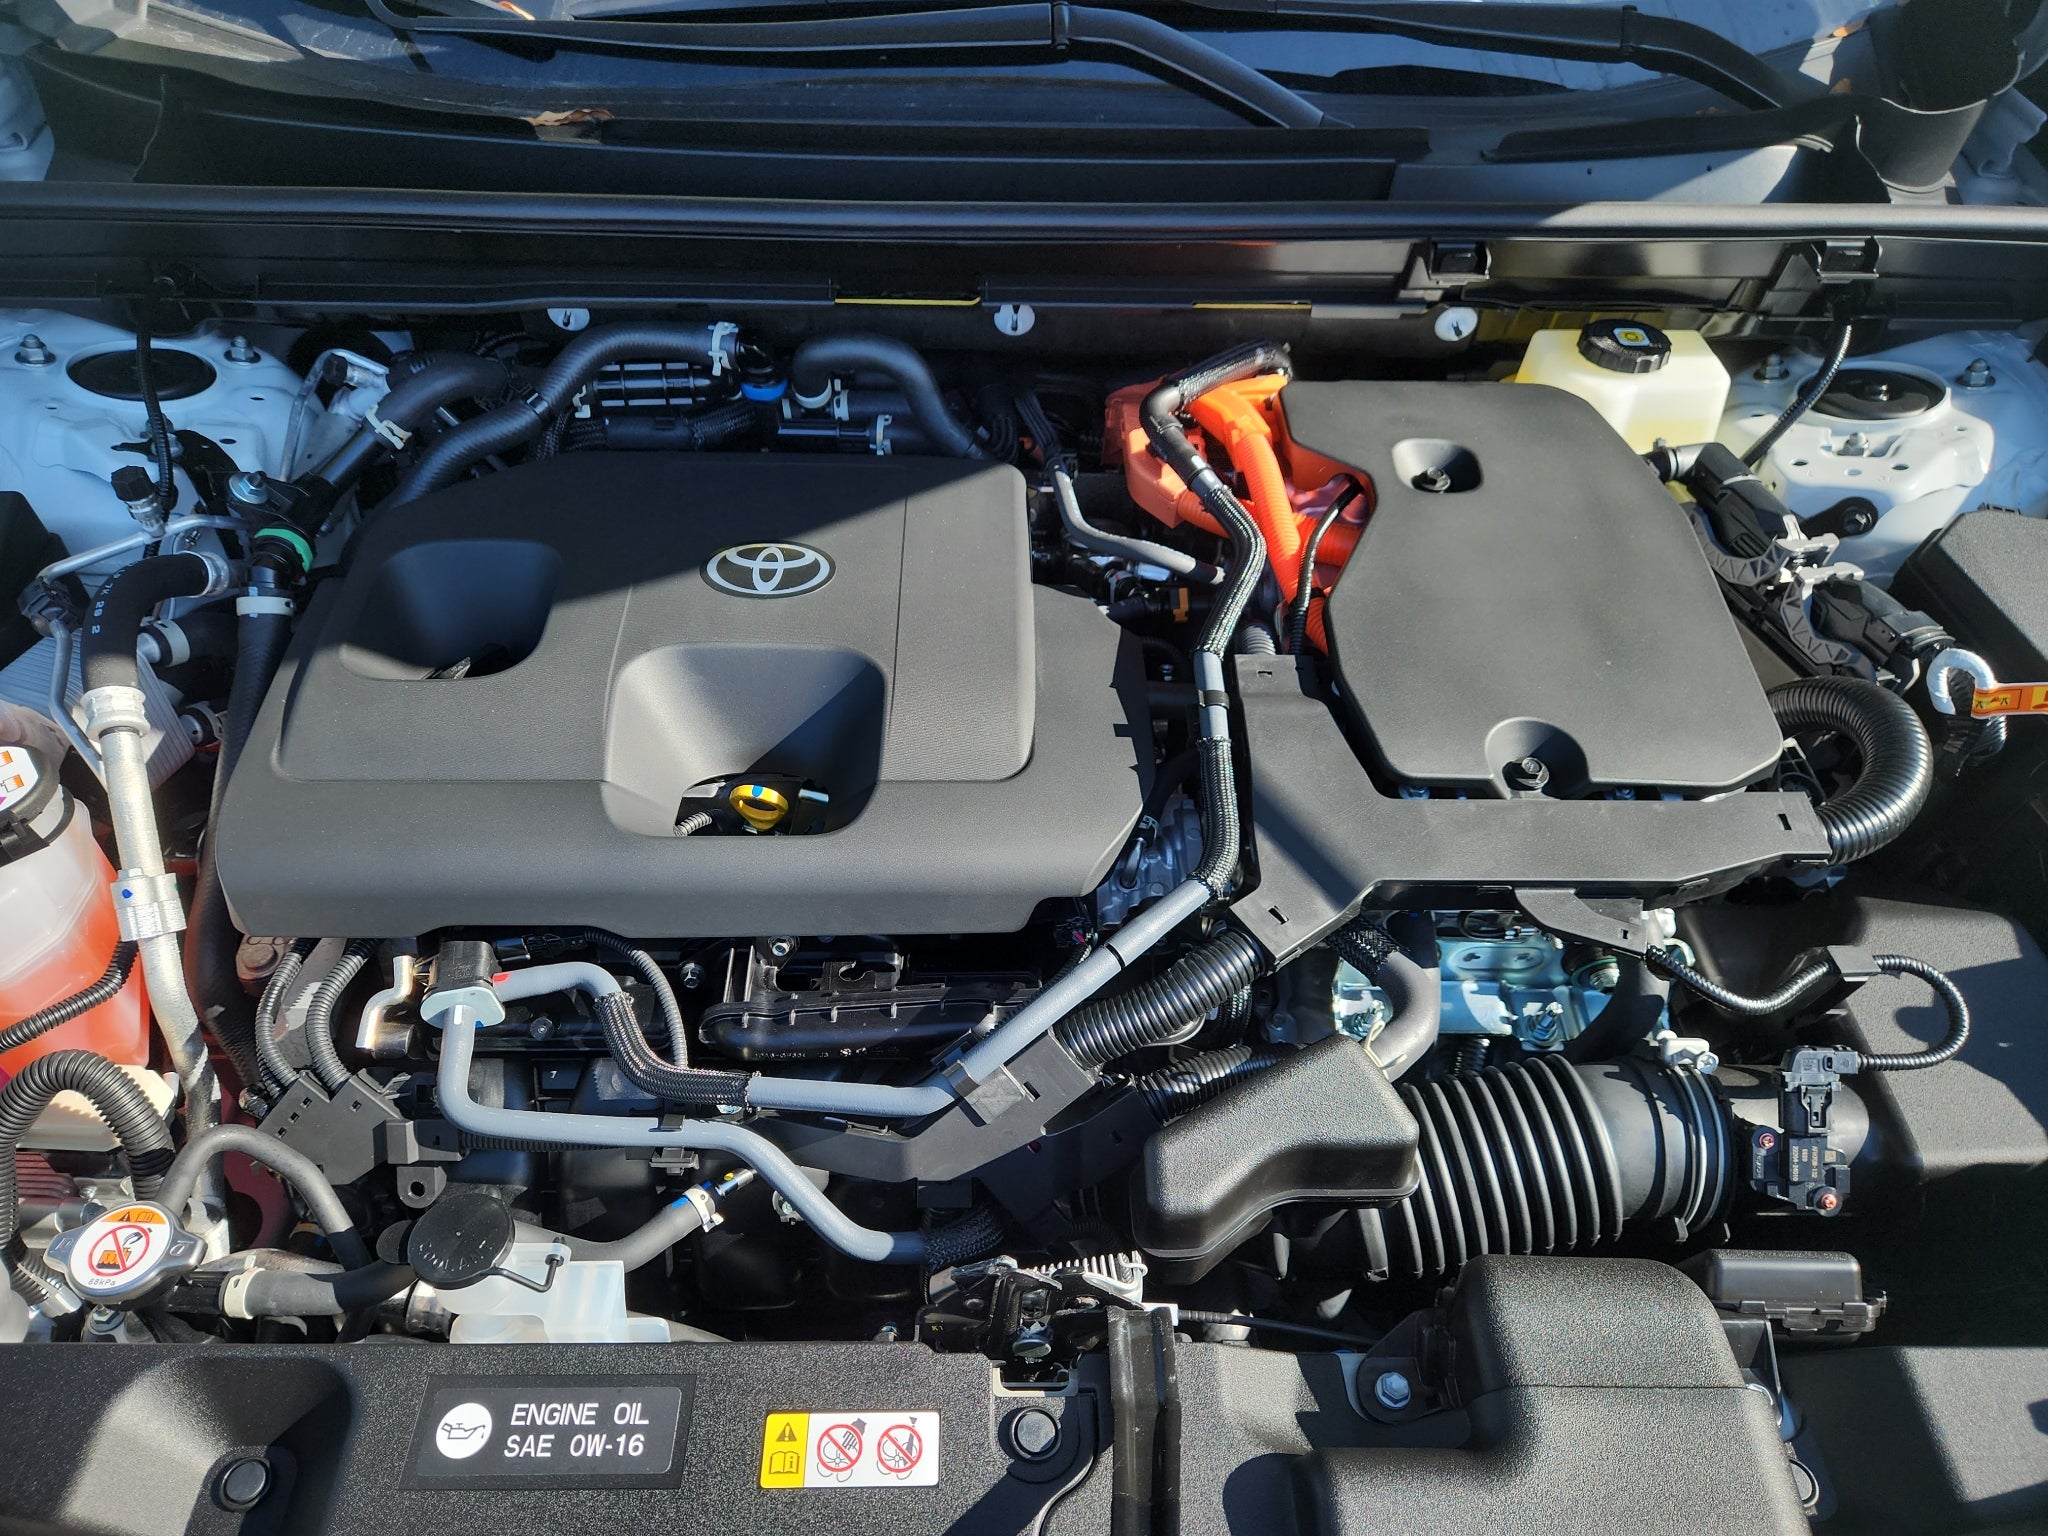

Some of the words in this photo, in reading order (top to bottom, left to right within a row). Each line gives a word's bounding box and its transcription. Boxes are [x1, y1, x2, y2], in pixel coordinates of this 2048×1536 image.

[88, 1278, 116, 1286] 88kPa
[510, 1402, 599, 1426] ENGINE
[613, 1402, 649, 1425] OIL
[503, 1434, 555, 1458] SAE
[569, 1433, 645, 1457] 0W-16
